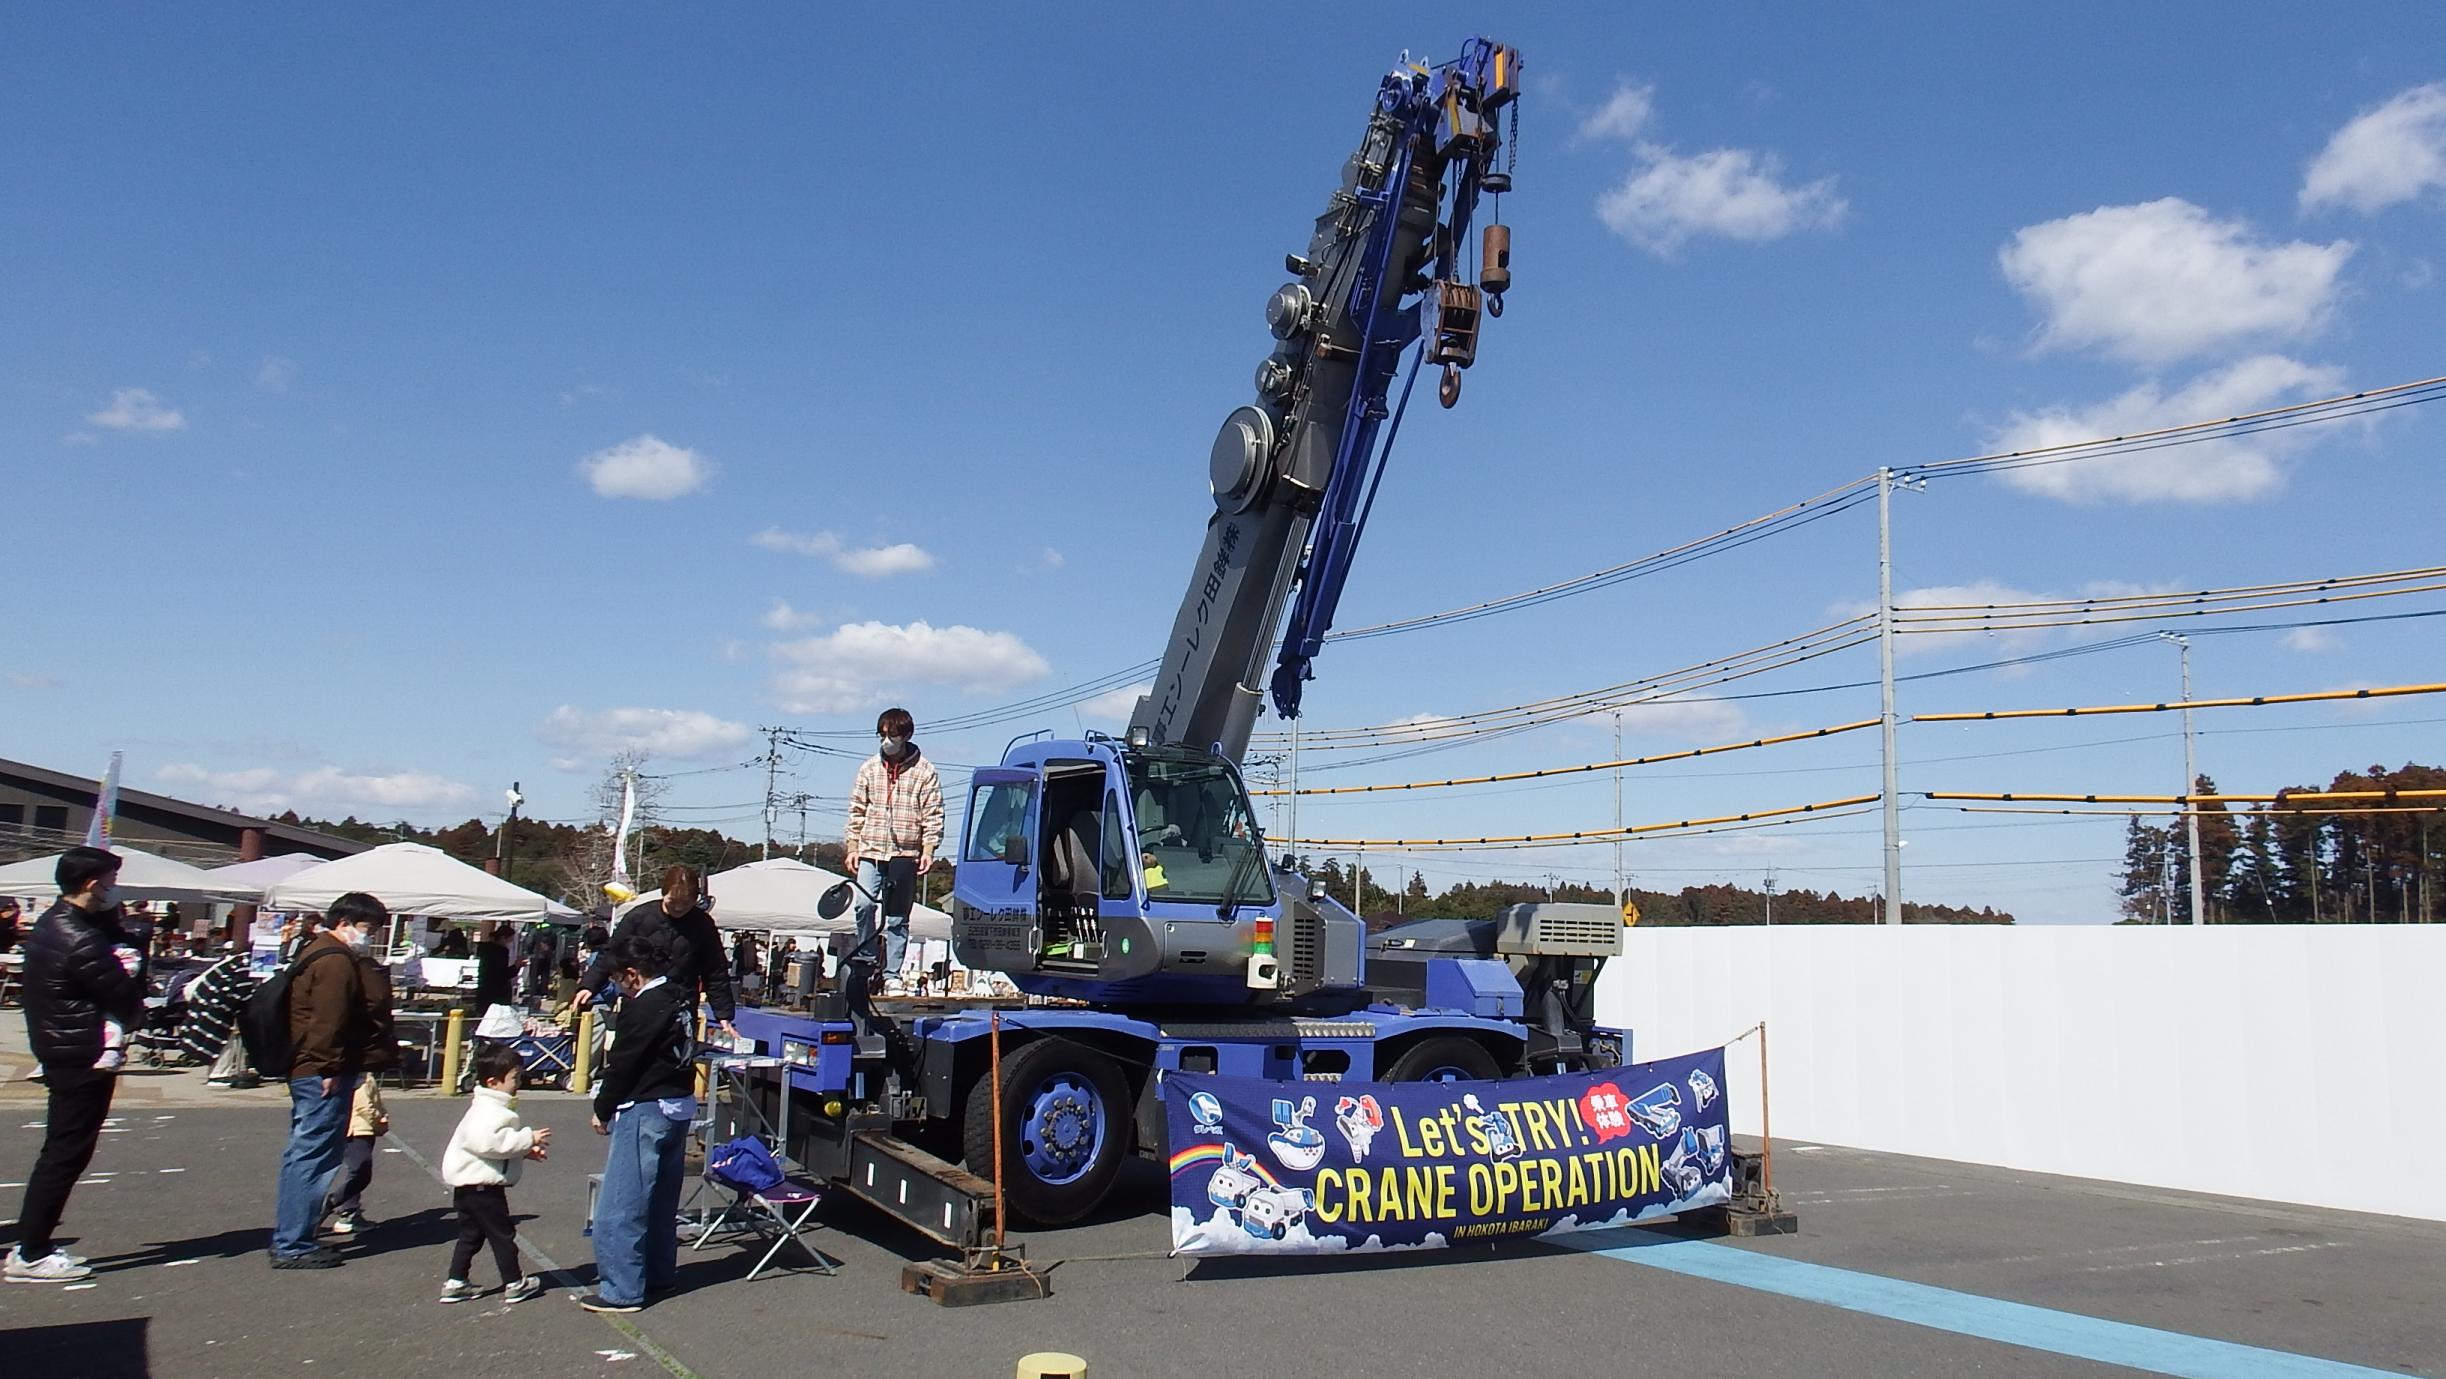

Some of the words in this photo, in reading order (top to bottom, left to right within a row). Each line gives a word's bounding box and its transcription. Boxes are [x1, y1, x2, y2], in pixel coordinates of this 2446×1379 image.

[1590, 1094, 1619, 1112] 乗車
[1390, 1103, 1490, 1157] Let's
[1498, 1098, 1590, 1152] TRY!
[1596, 1110, 1626, 1129] 体験
[1315, 1164, 1457, 1223] CRANE
[1469, 1143, 1661, 1215] OPERATION
[1453, 1225, 1467, 1238] IN
[1466, 1221, 1507, 1237] HOKOTA
[1508, 1217, 1550, 1233] IBARAKI
